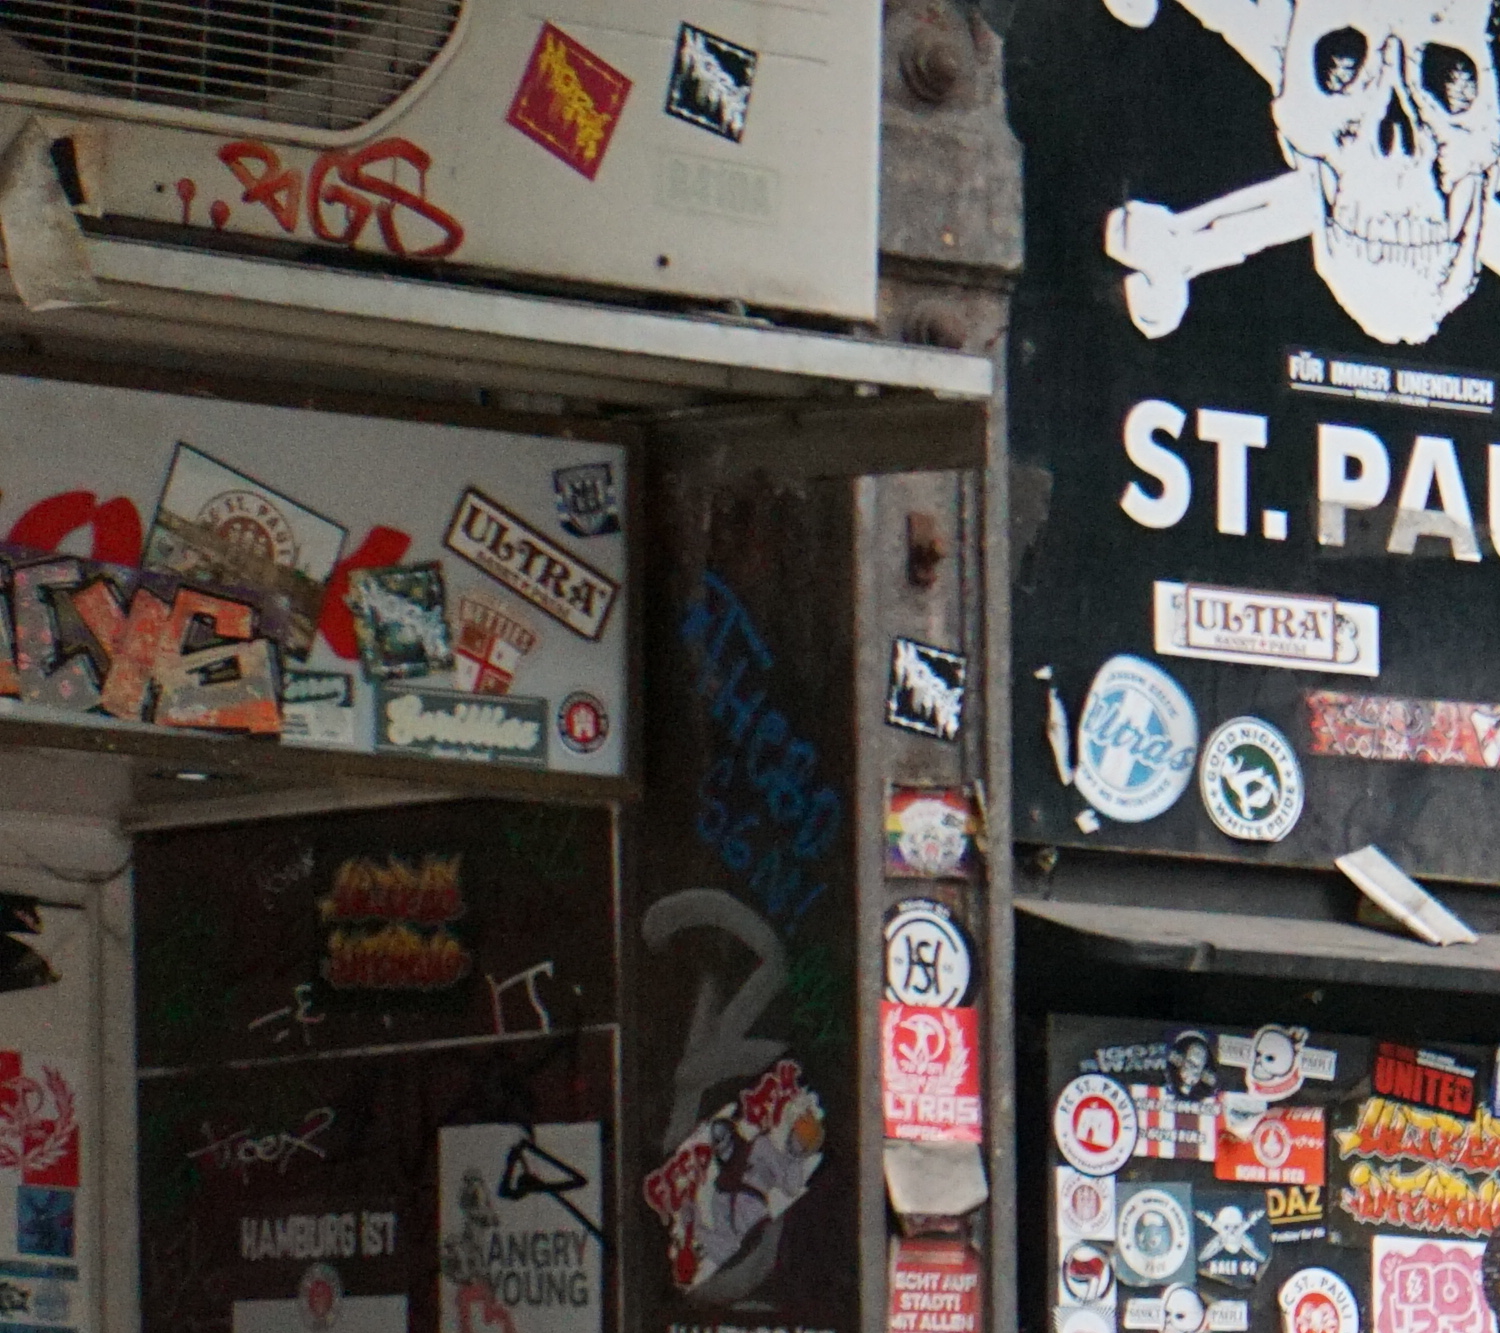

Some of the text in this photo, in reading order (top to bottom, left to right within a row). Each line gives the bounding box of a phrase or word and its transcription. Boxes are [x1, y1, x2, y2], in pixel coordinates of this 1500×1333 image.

[1289, 351, 1496, 406] FÜR IMMER UNENDLICH
[1120, 398, 1289, 542] ST.
[1195, 598, 1325, 642] ULTRA
[1207, 728, 1288, 783] GOOD NIGHT
[1266, 1186, 1323, 1215] DAZ
[242, 1214, 357, 1260] HAMBURG
